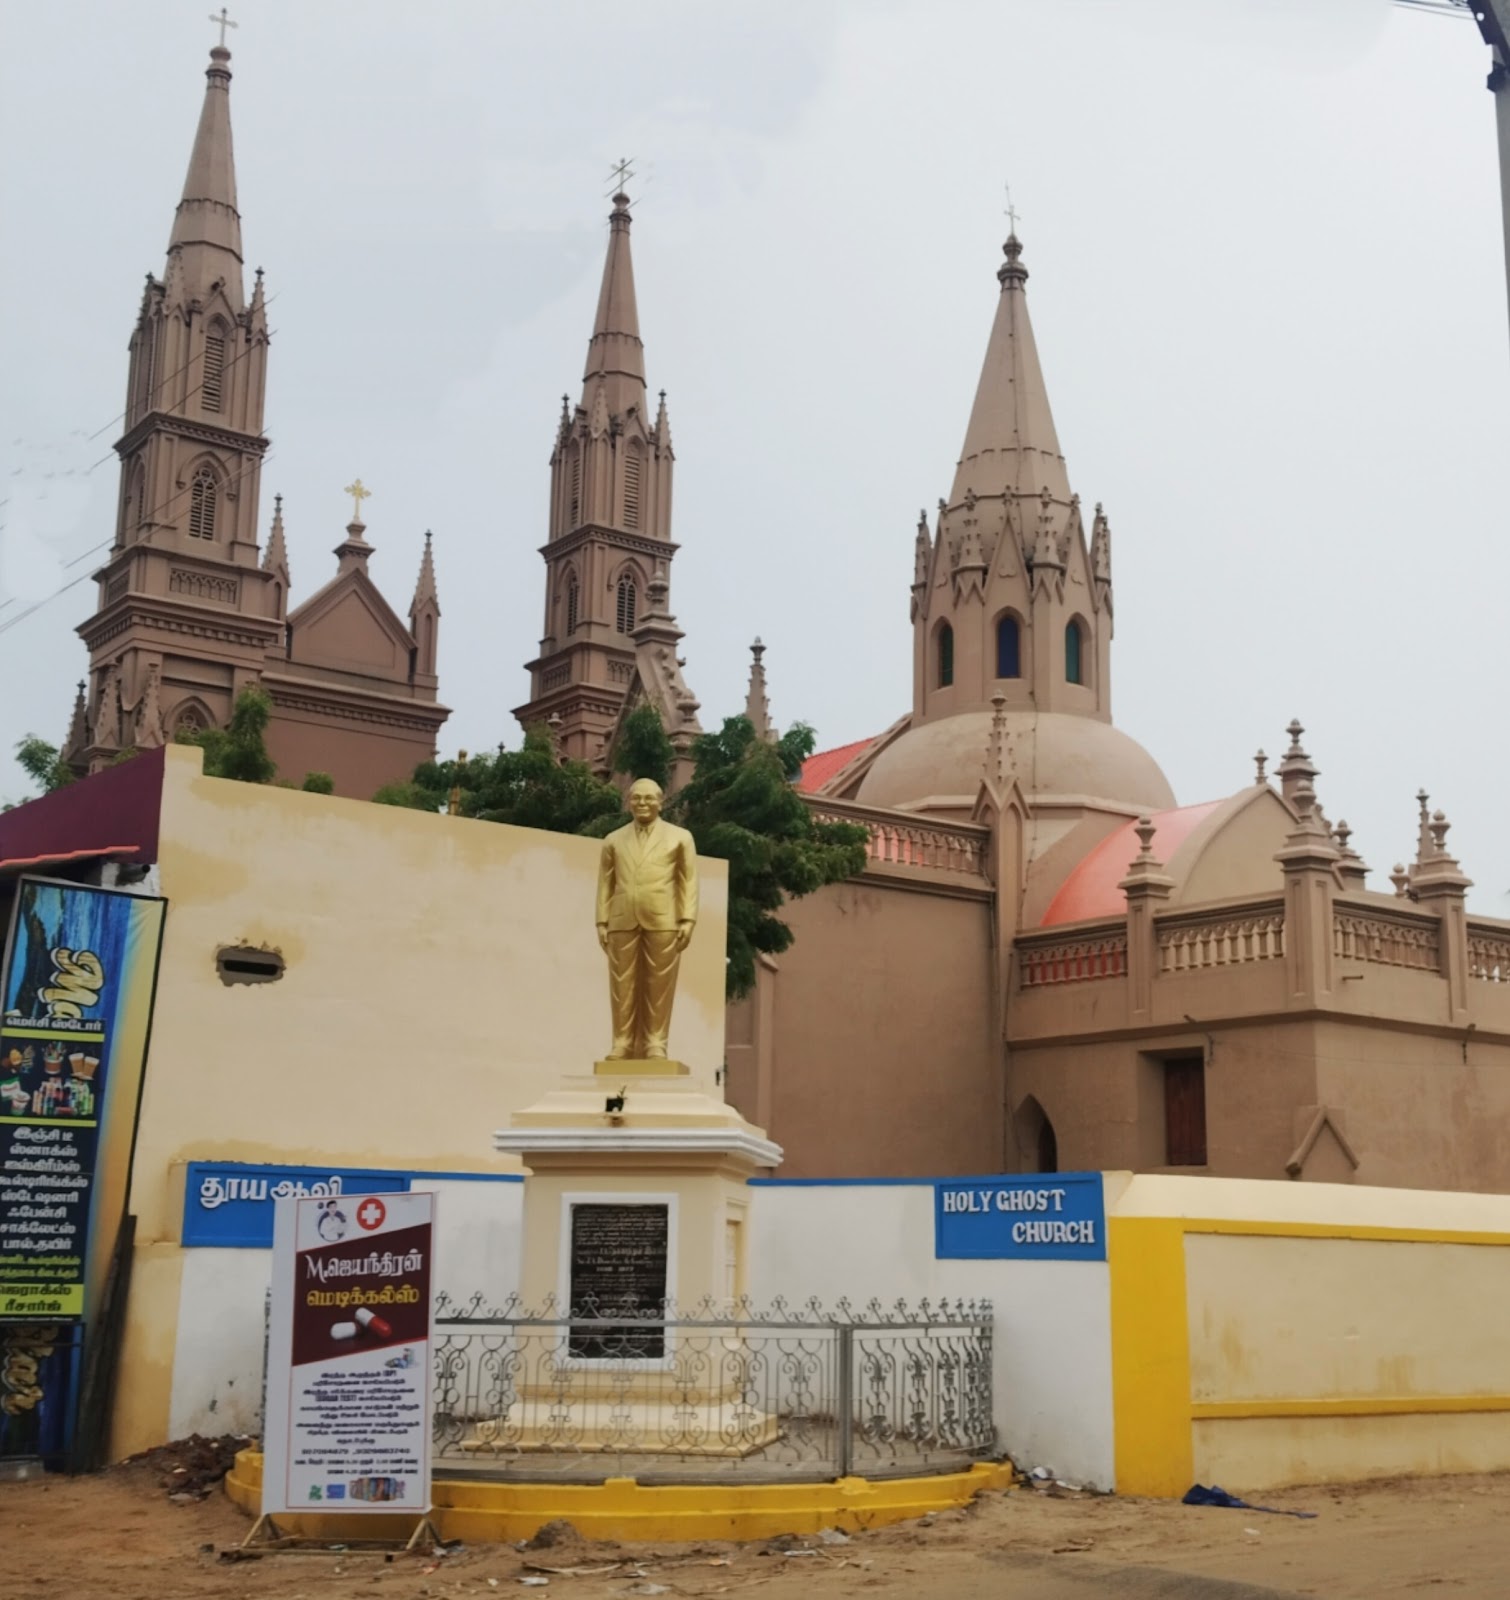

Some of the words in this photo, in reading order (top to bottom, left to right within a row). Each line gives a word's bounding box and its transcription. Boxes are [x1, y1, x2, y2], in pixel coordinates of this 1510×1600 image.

[6, 1016, 50, 1029] மெர்சி
[51, 1018, 102, 1032] ஸ்டோர்
[200, 1177, 267, 1209] தூய
[943, 1190, 993, 1213] HOLY
[996, 1188, 1066, 1212] GHOST
[1012, 1220, 1095, 1244] CHURCH
[306, 1284, 420, 1308] மெடிக்கல்ஸ்
